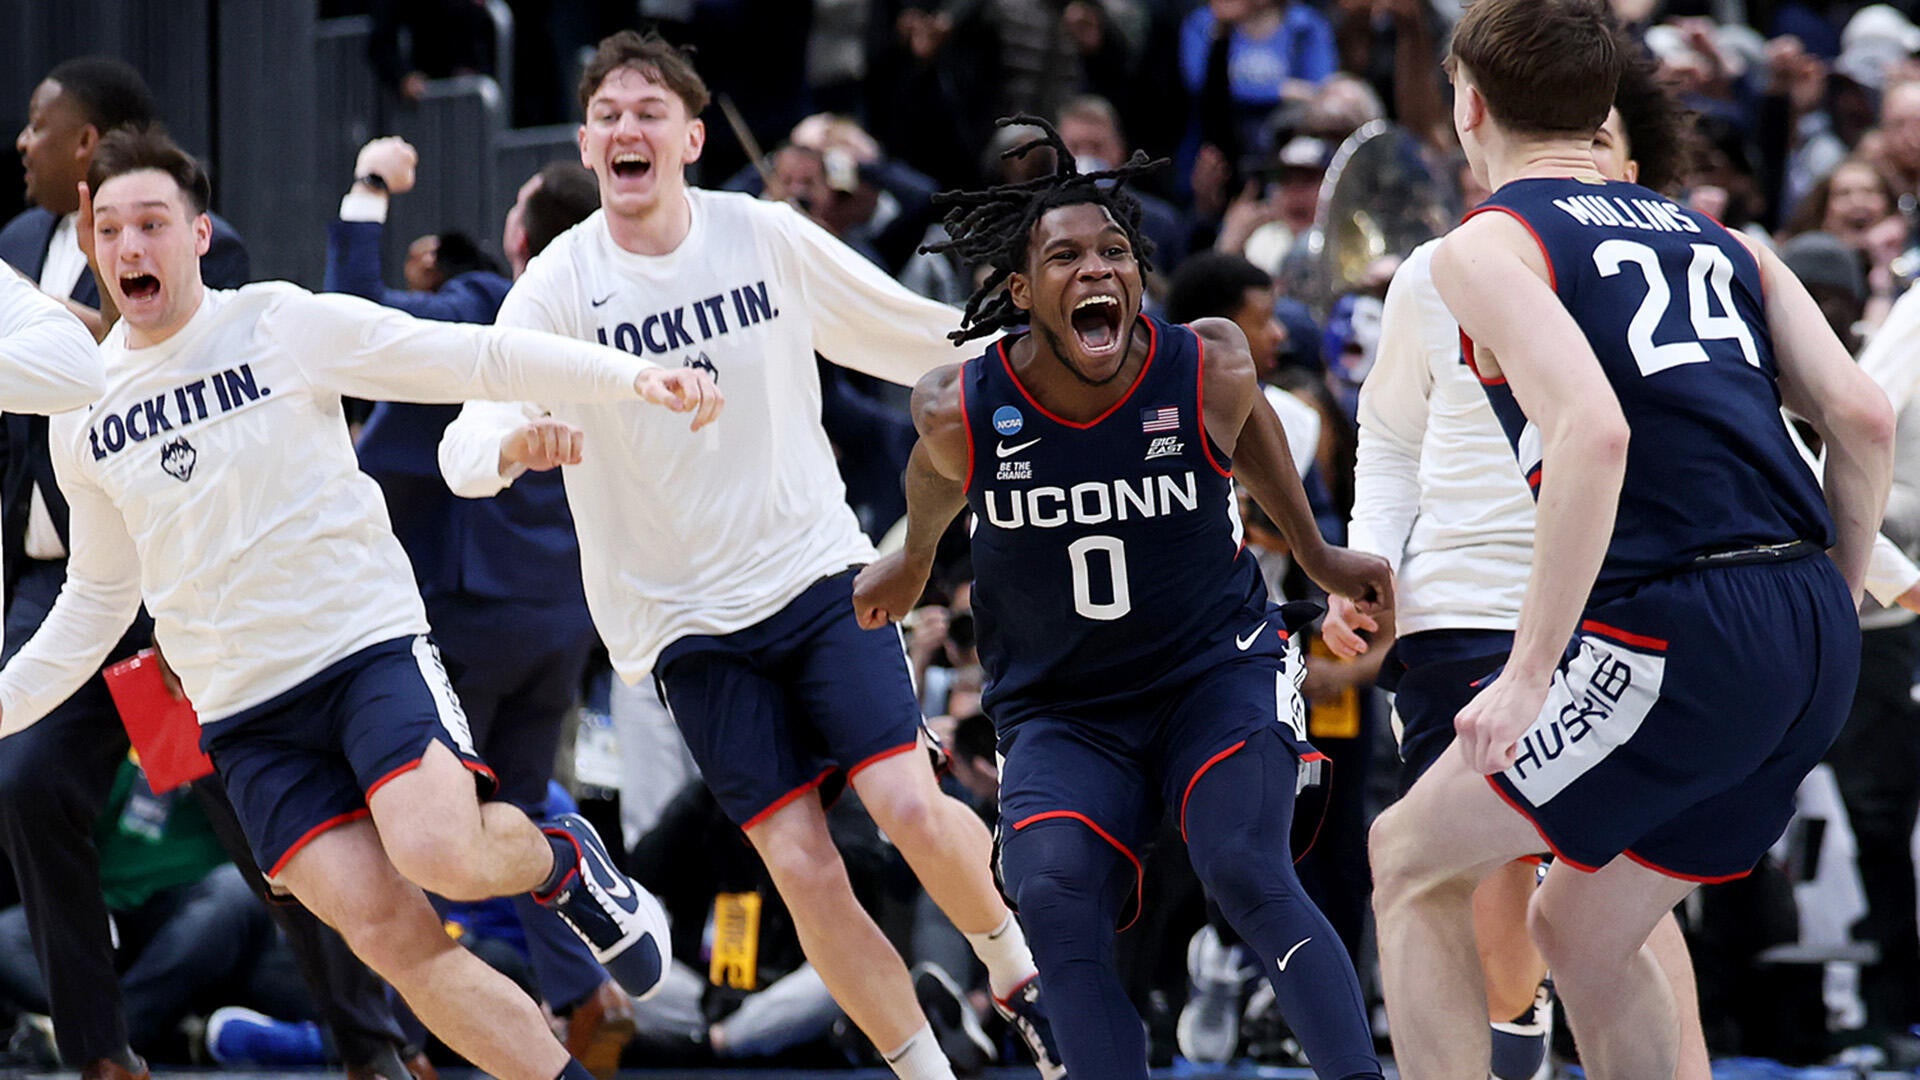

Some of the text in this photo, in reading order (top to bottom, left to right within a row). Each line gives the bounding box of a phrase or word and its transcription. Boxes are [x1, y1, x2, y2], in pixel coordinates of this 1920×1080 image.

[1552, 195, 1701, 233] MULLINS
[693, 294, 729, 341] IT
[731, 280, 779, 328] IN.
[1592, 239, 1760, 377] 24
[89, 394, 174, 462] LOCK
[174, 378, 209, 427] IT
[211, 363, 271, 413] IN.
[997, 418, 1022, 429] NCAA
[1147, 443, 1185, 456] EAST
[1151, 436, 1178, 447] BIG
[997, 470, 1033, 480] CHANGE
[1000, 460, 1031, 471] BE THE
[984, 471, 1198, 529] UCONN
[1068, 535, 1131, 620] 0
